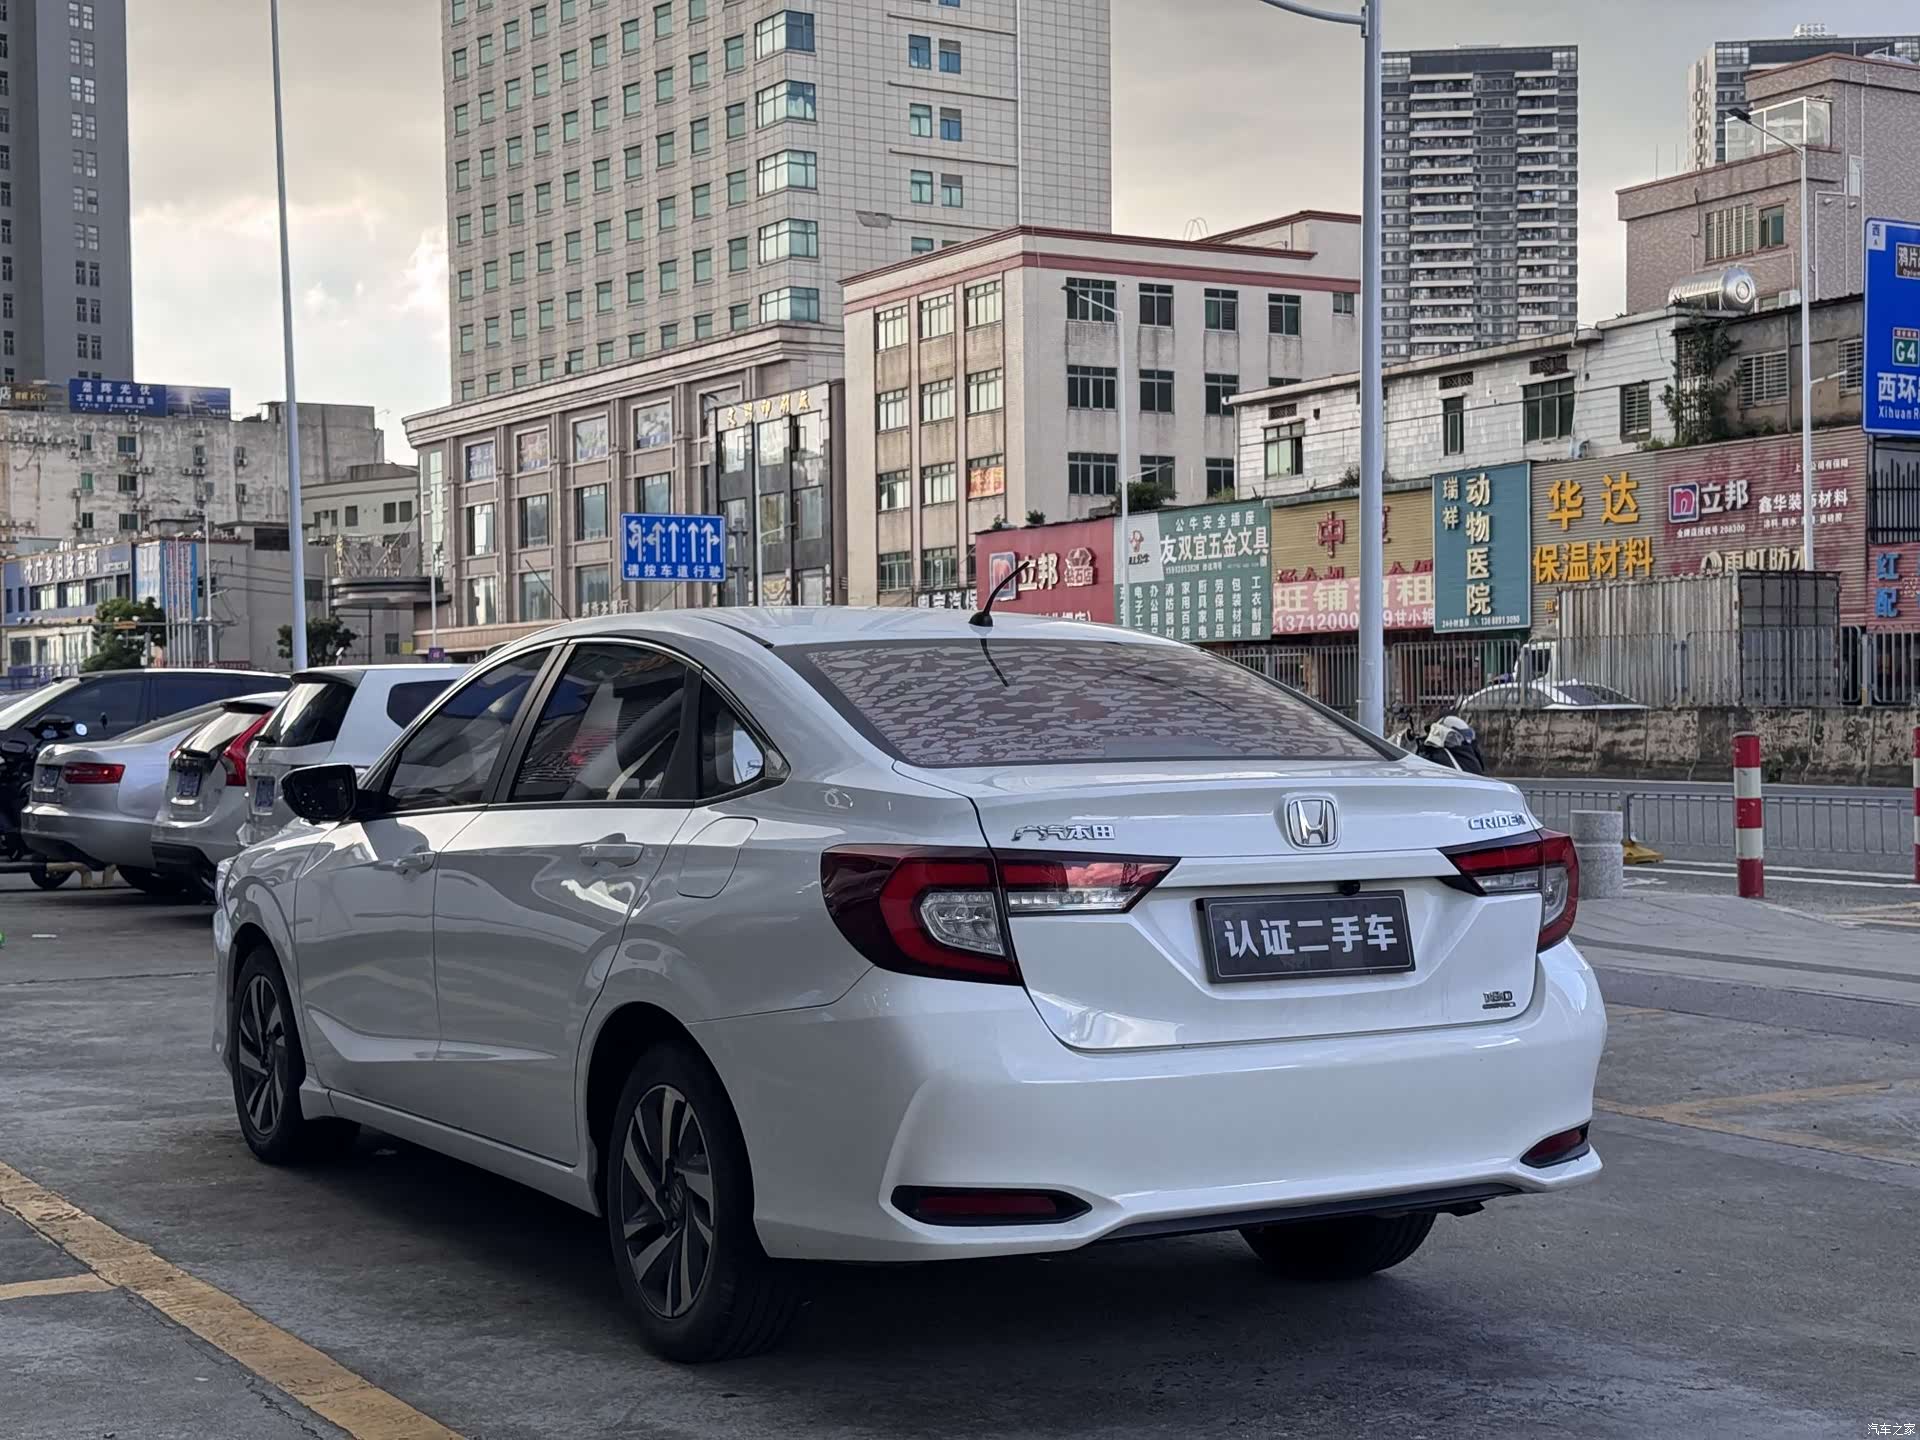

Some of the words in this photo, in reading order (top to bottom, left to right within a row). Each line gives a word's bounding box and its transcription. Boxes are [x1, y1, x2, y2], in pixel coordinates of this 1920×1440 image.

[1898, 246, 1920, 268] 鸦片
[1877, 372, 1920, 404] 西环
[1878, 405, 1912, 420] Xihuan
[1793, 458, 1849, 473] 上公司有保障
[1443, 475, 1459, 531] 瑞祥
[1546, 471, 1640, 532] 华达
[1701, 479, 1749, 514] 立邦
[1175, 511, 1255, 532] 公牛安全插座
[1160, 526, 1269, 564] 友双宜五金文具
[1466, 472, 1491, 617] 动物医院
[1533, 536, 1654, 584] 保温材料
[627, 563, 722, 578] 请按车道行驶
[1018, 554, 1058, 592] 立邦
[1134, 586, 1144, 630] 电子工
[1181, 581, 1191, 640] 家用百货
[1198, 579, 1208, 639] 厨具家电
[1215, 578, 1225, 638] 劳保用品
[1232, 577, 1242, 638] 包装材料
[1251, 575, 1262, 636] 工衣制服
[1012, 824, 1115, 842] 广汽本田
[1224, 913, 1398, 958] 认证二手车
